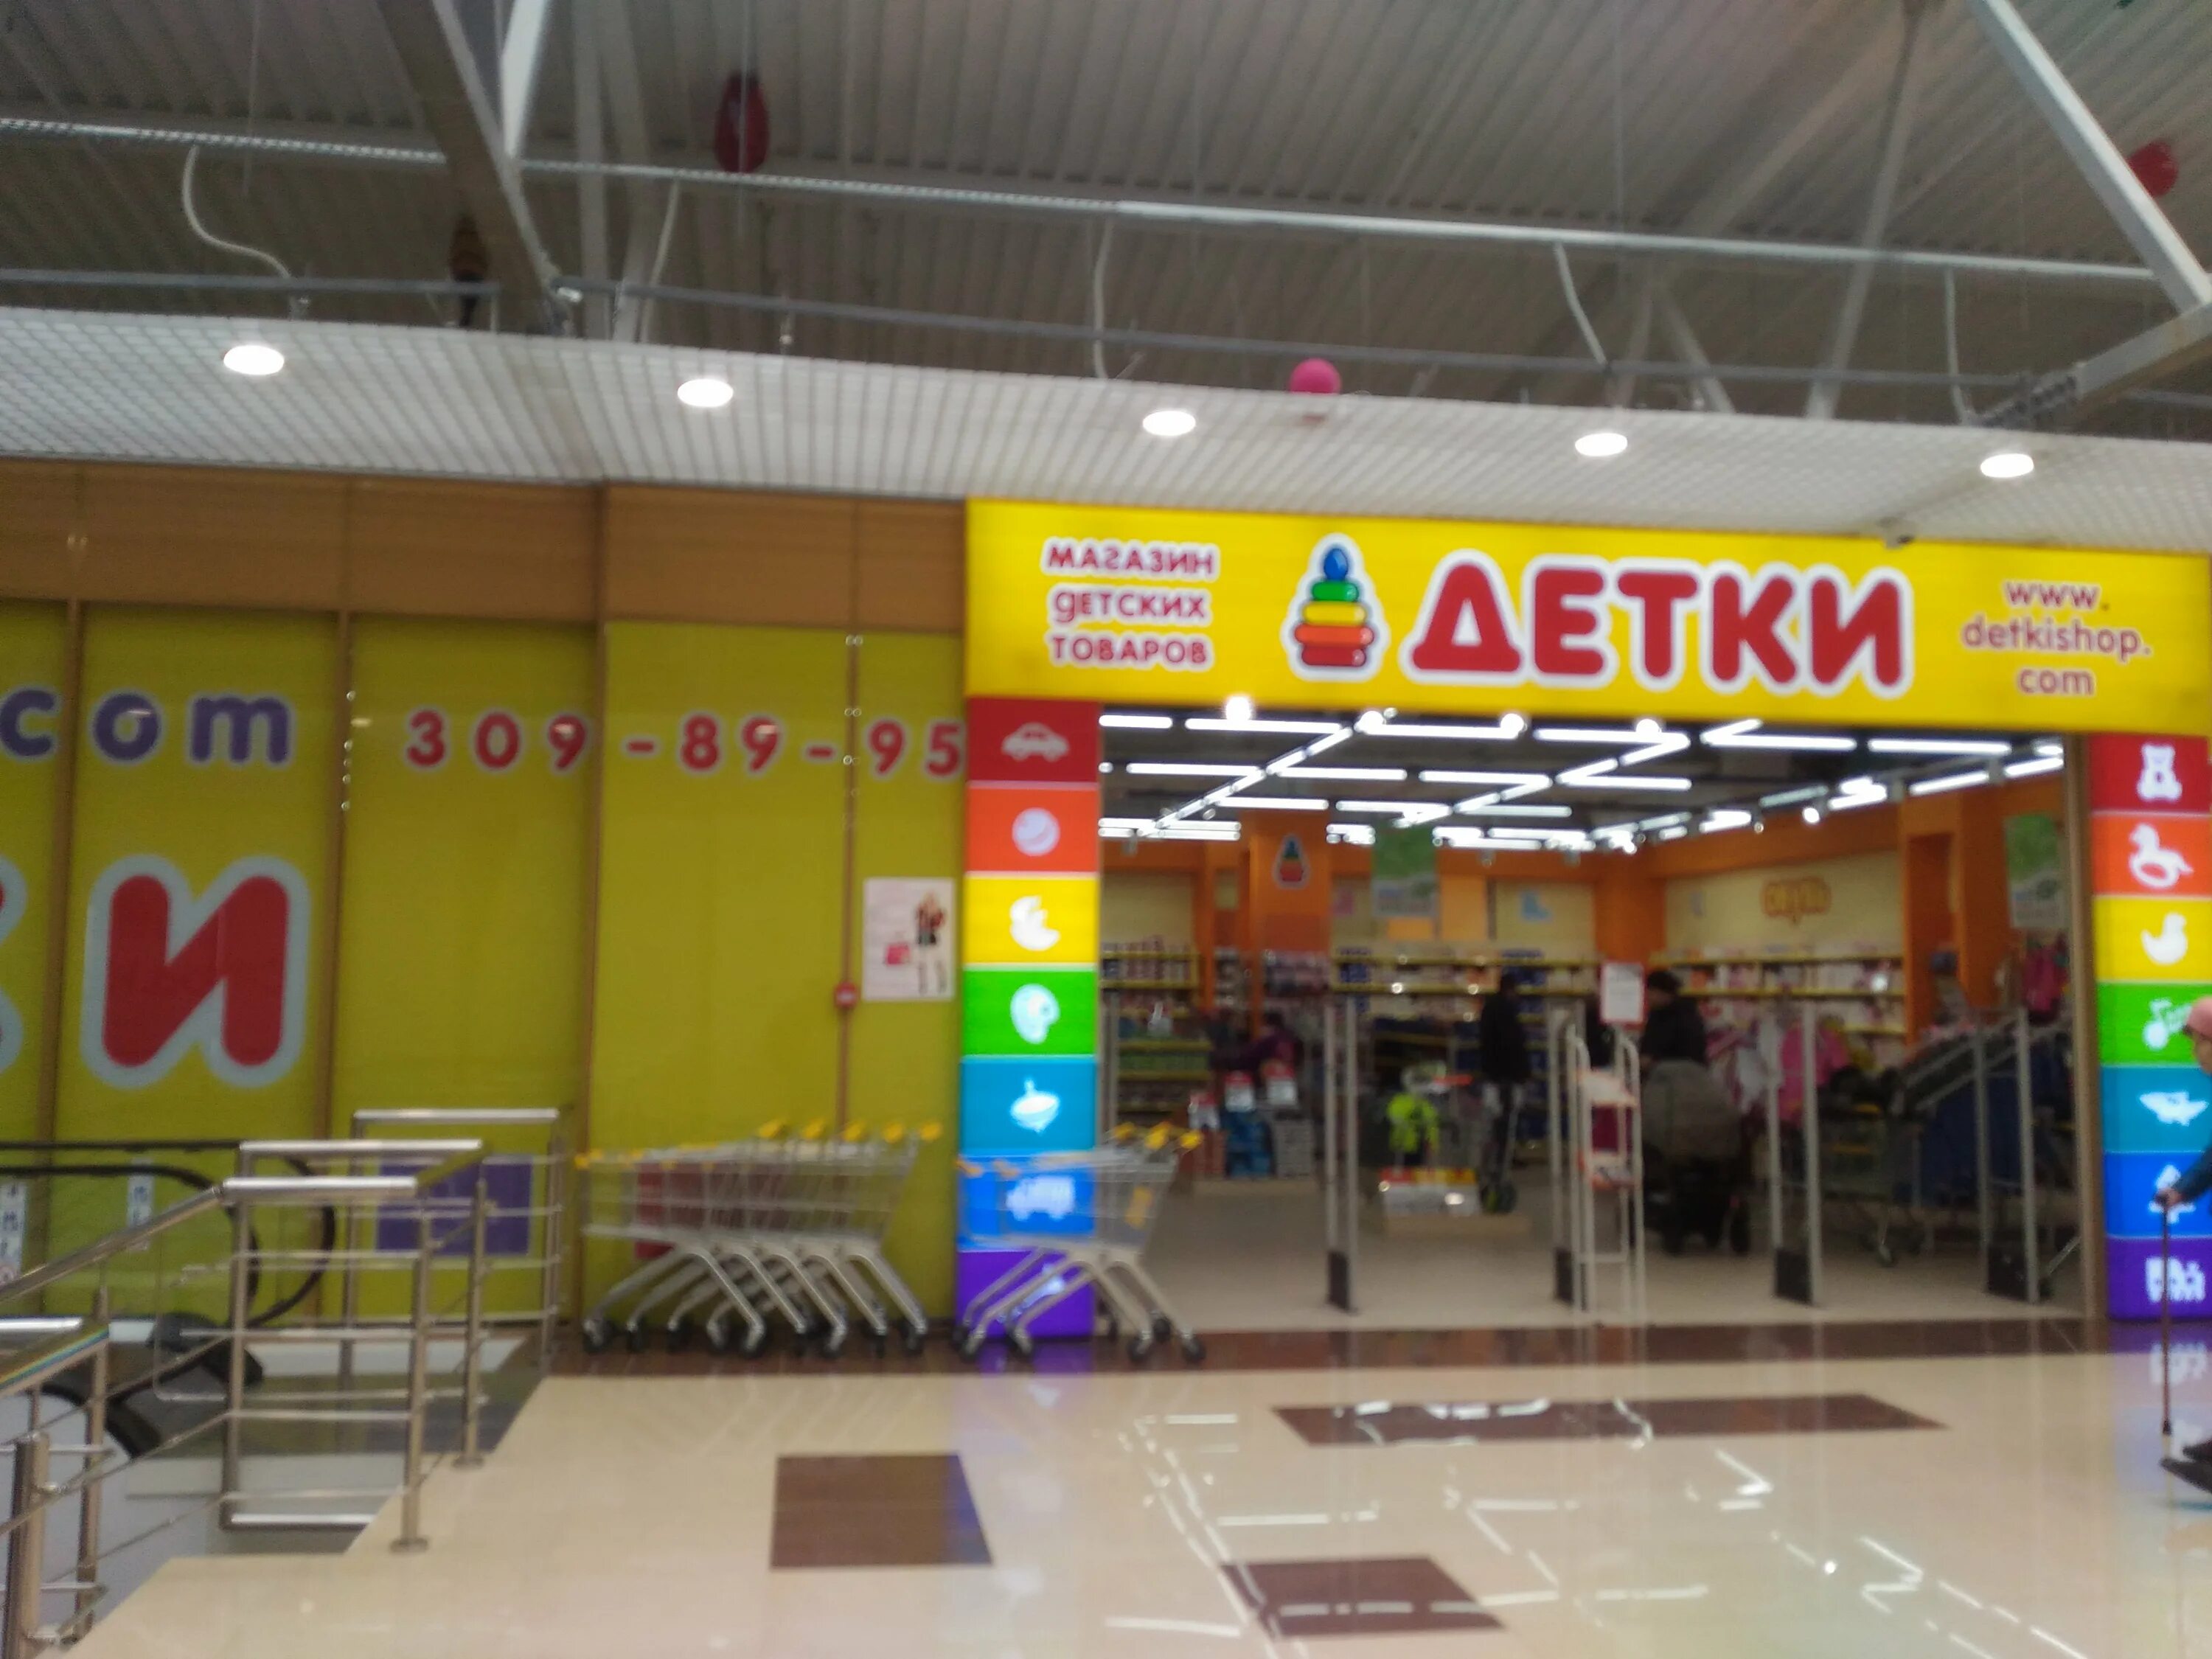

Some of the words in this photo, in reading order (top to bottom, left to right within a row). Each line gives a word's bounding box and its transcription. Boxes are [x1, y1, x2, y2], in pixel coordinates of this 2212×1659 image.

[1411, 560, 1902, 689] ДЕТКИ
[1052, 635, 1207, 665] ТОВАРОВ
[2019, 669, 2094, 695] com
